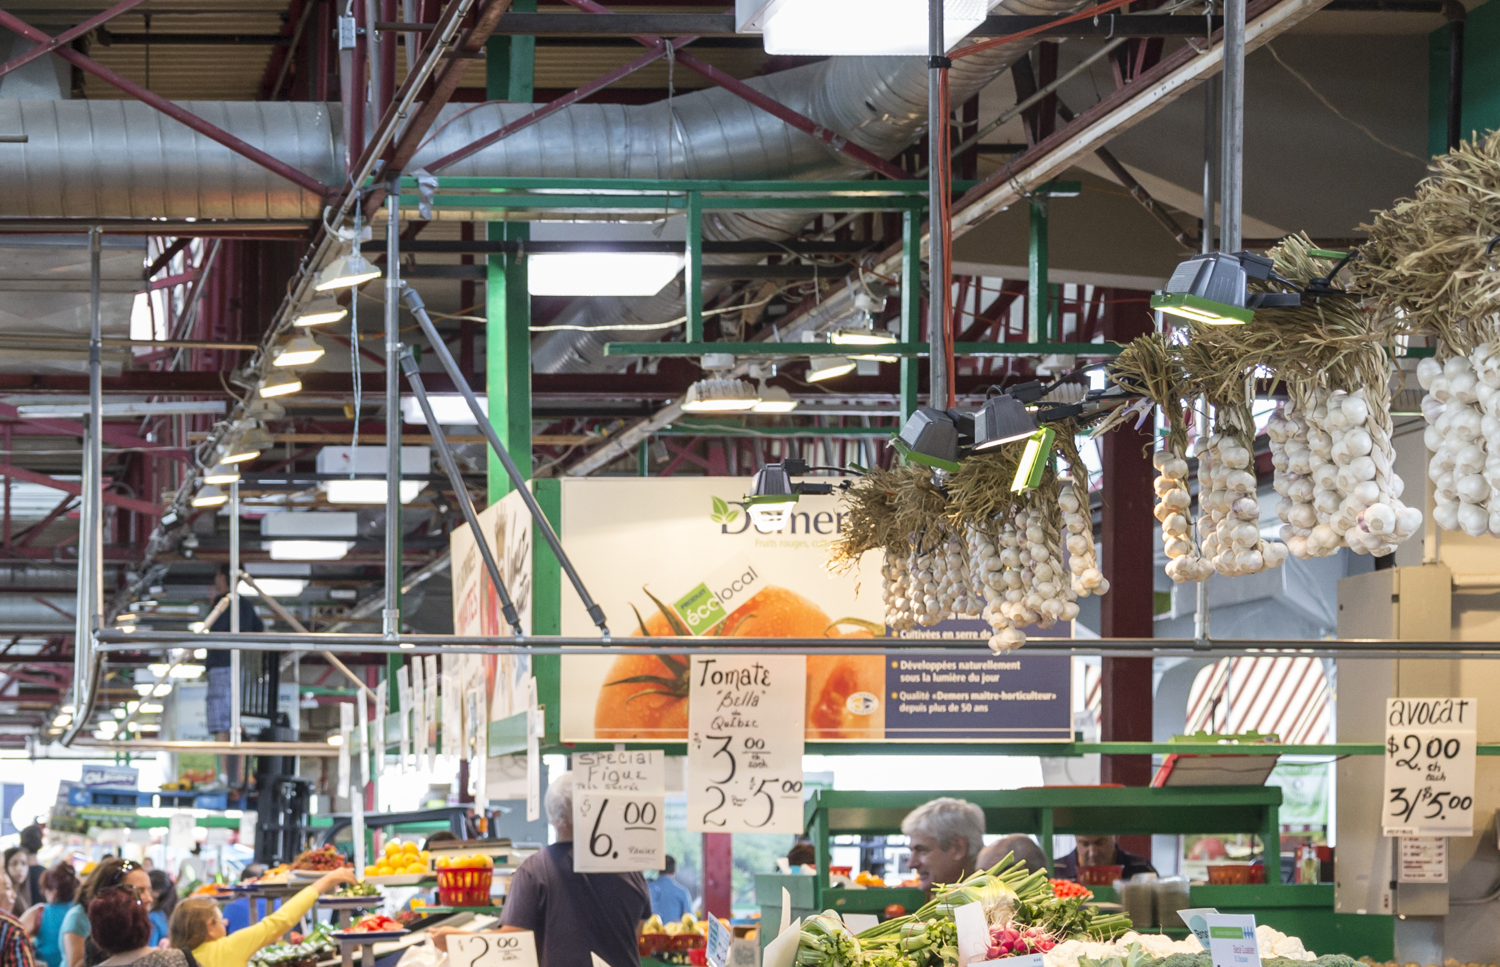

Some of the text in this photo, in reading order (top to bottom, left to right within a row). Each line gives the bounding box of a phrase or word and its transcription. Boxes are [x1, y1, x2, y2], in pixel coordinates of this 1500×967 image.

[721, 501, 849, 535] Dmer
[900, 630, 941, 640] Cultivées
[942, 630, 955, 640] en
[956, 630, 979, 640] serre
[900, 660, 1021, 672] Développées naturellement
[697, 659, 772, 691] Tomate
[900, 672, 1000, 684] sous la lumière du jour
[899, 691, 930, 702] Qualité
[899, 703, 989, 714] depuis plus de 50 ans
[703, 785, 727, 826] 2
